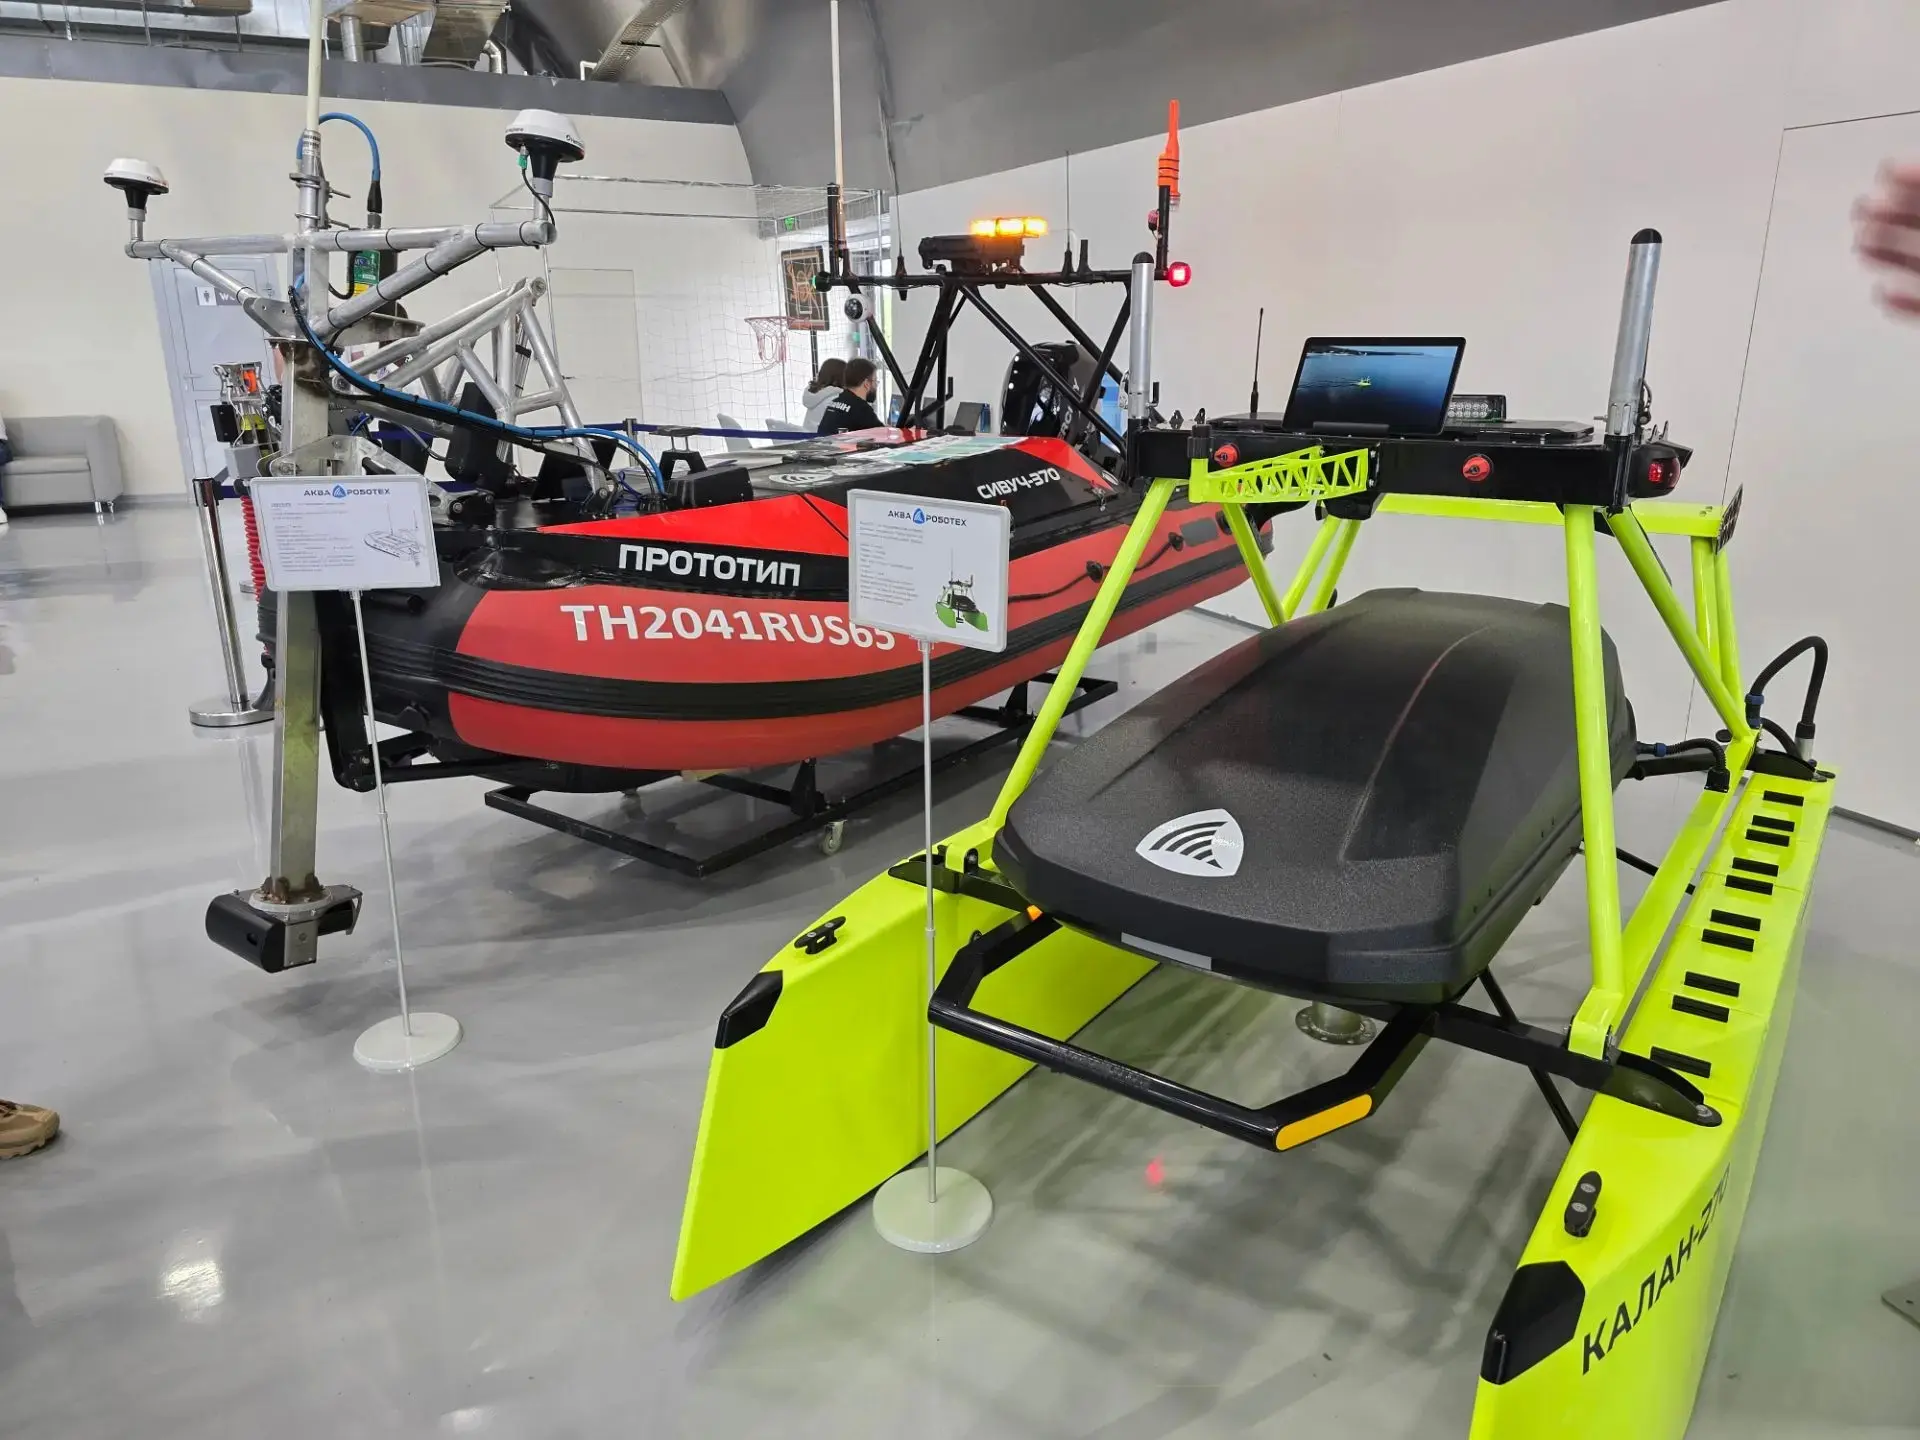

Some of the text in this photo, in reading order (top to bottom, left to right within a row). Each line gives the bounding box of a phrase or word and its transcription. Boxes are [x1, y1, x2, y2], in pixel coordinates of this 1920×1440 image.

[303, 488, 391, 497] АКВА РОБОТЕХ
[976, 467, 1061, 499] СИВУЧ-370
[887, 510, 968, 527] АКВА РОБОТЕХ
[618, 543, 801, 587] ПРОТОТИП
[1582, 1162, 1730, 1376] КАЛАН-270
